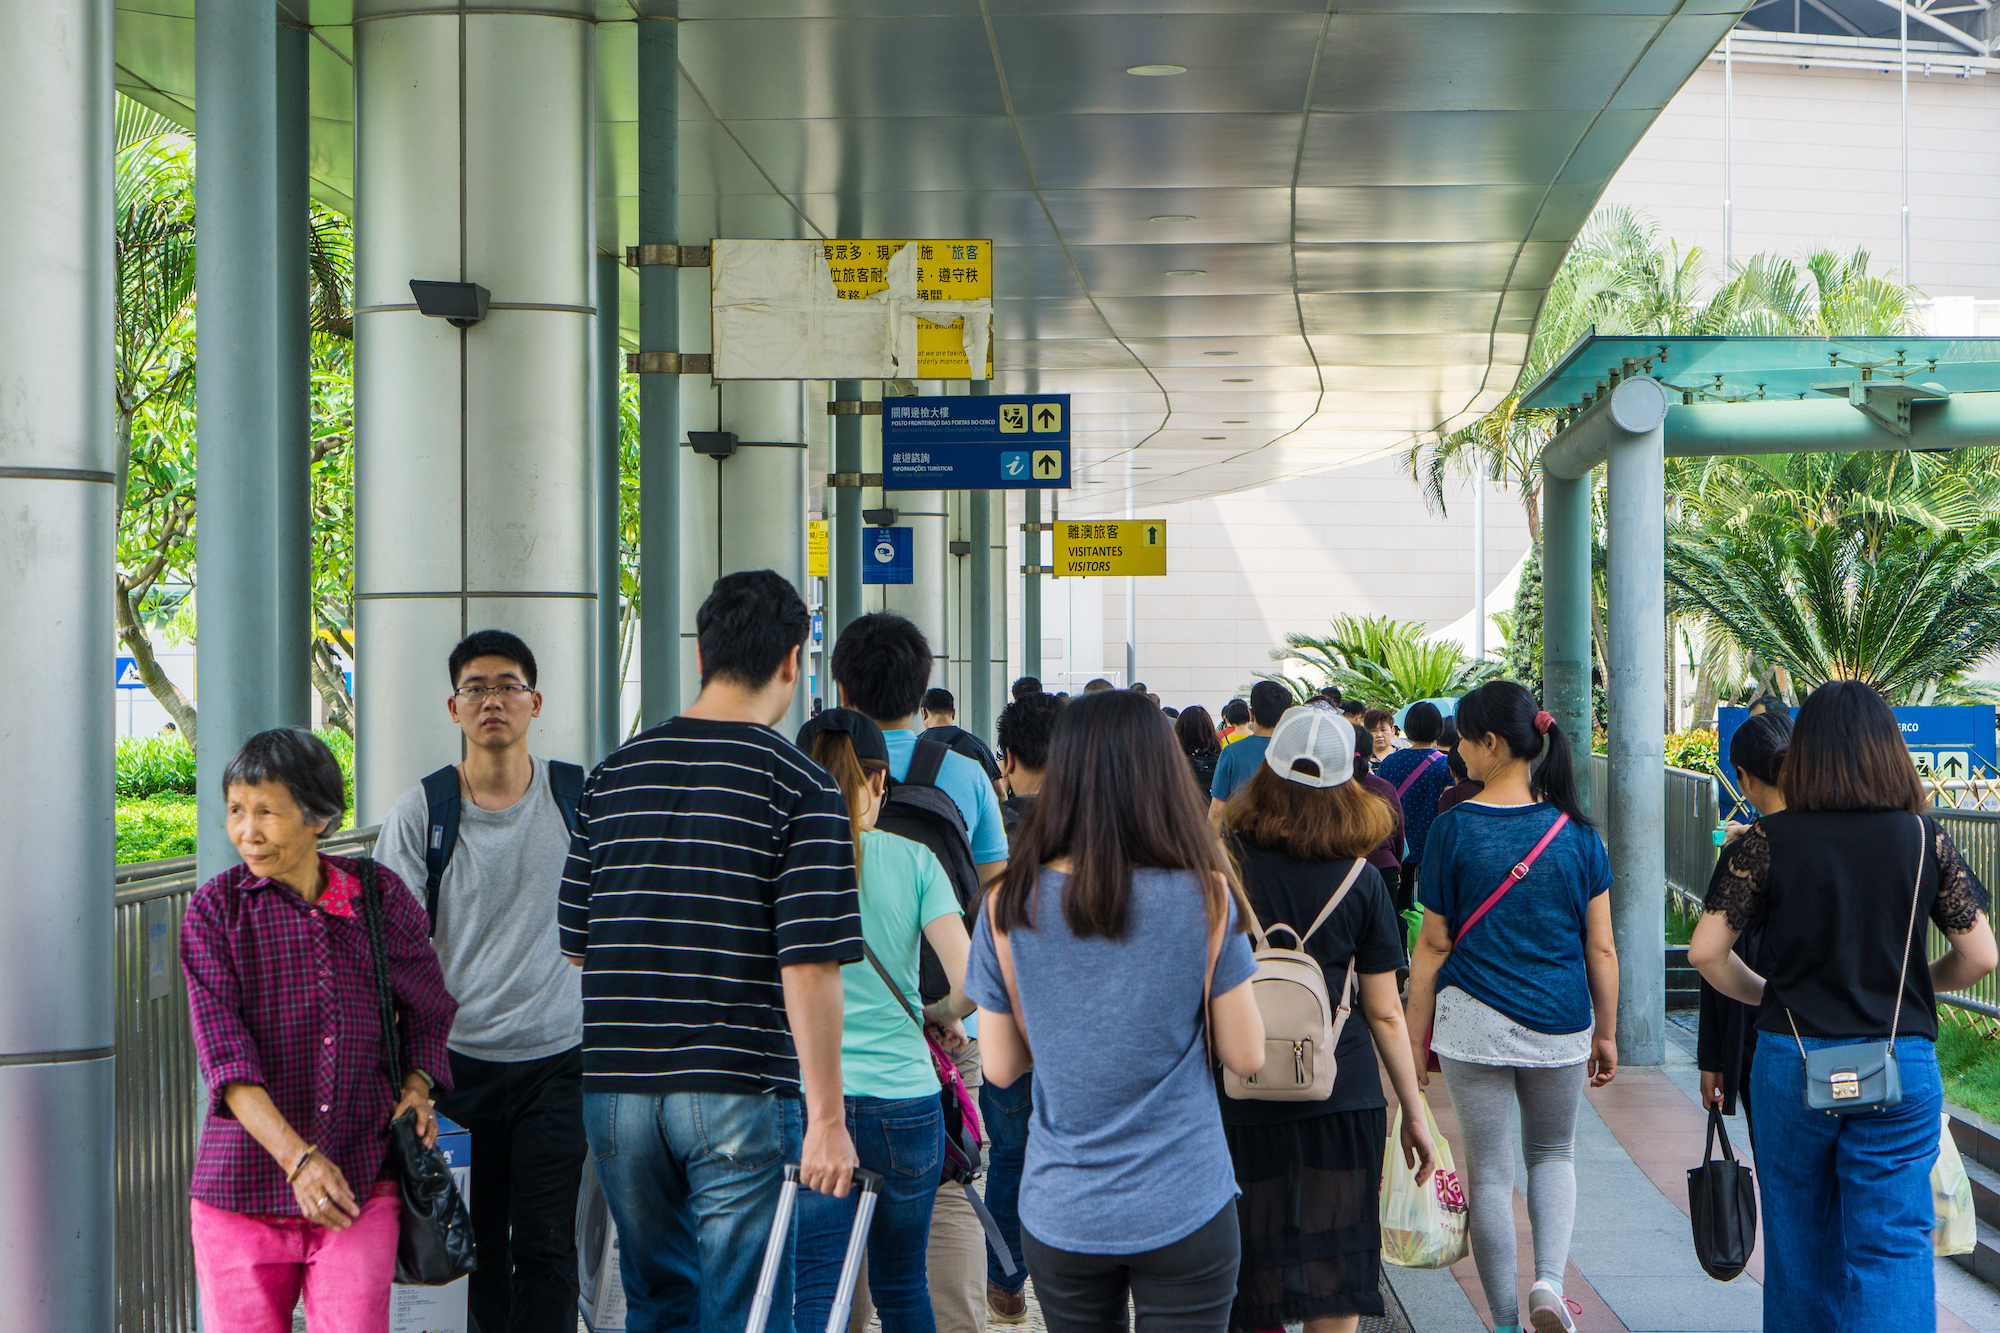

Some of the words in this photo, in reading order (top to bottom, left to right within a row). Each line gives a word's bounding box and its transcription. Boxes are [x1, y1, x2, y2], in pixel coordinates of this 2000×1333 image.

[1068, 525, 1119, 539] 離澳旅客
[1068, 547, 1122, 557] VISITANTES
[1068, 561, 1111, 572] VISITORS
